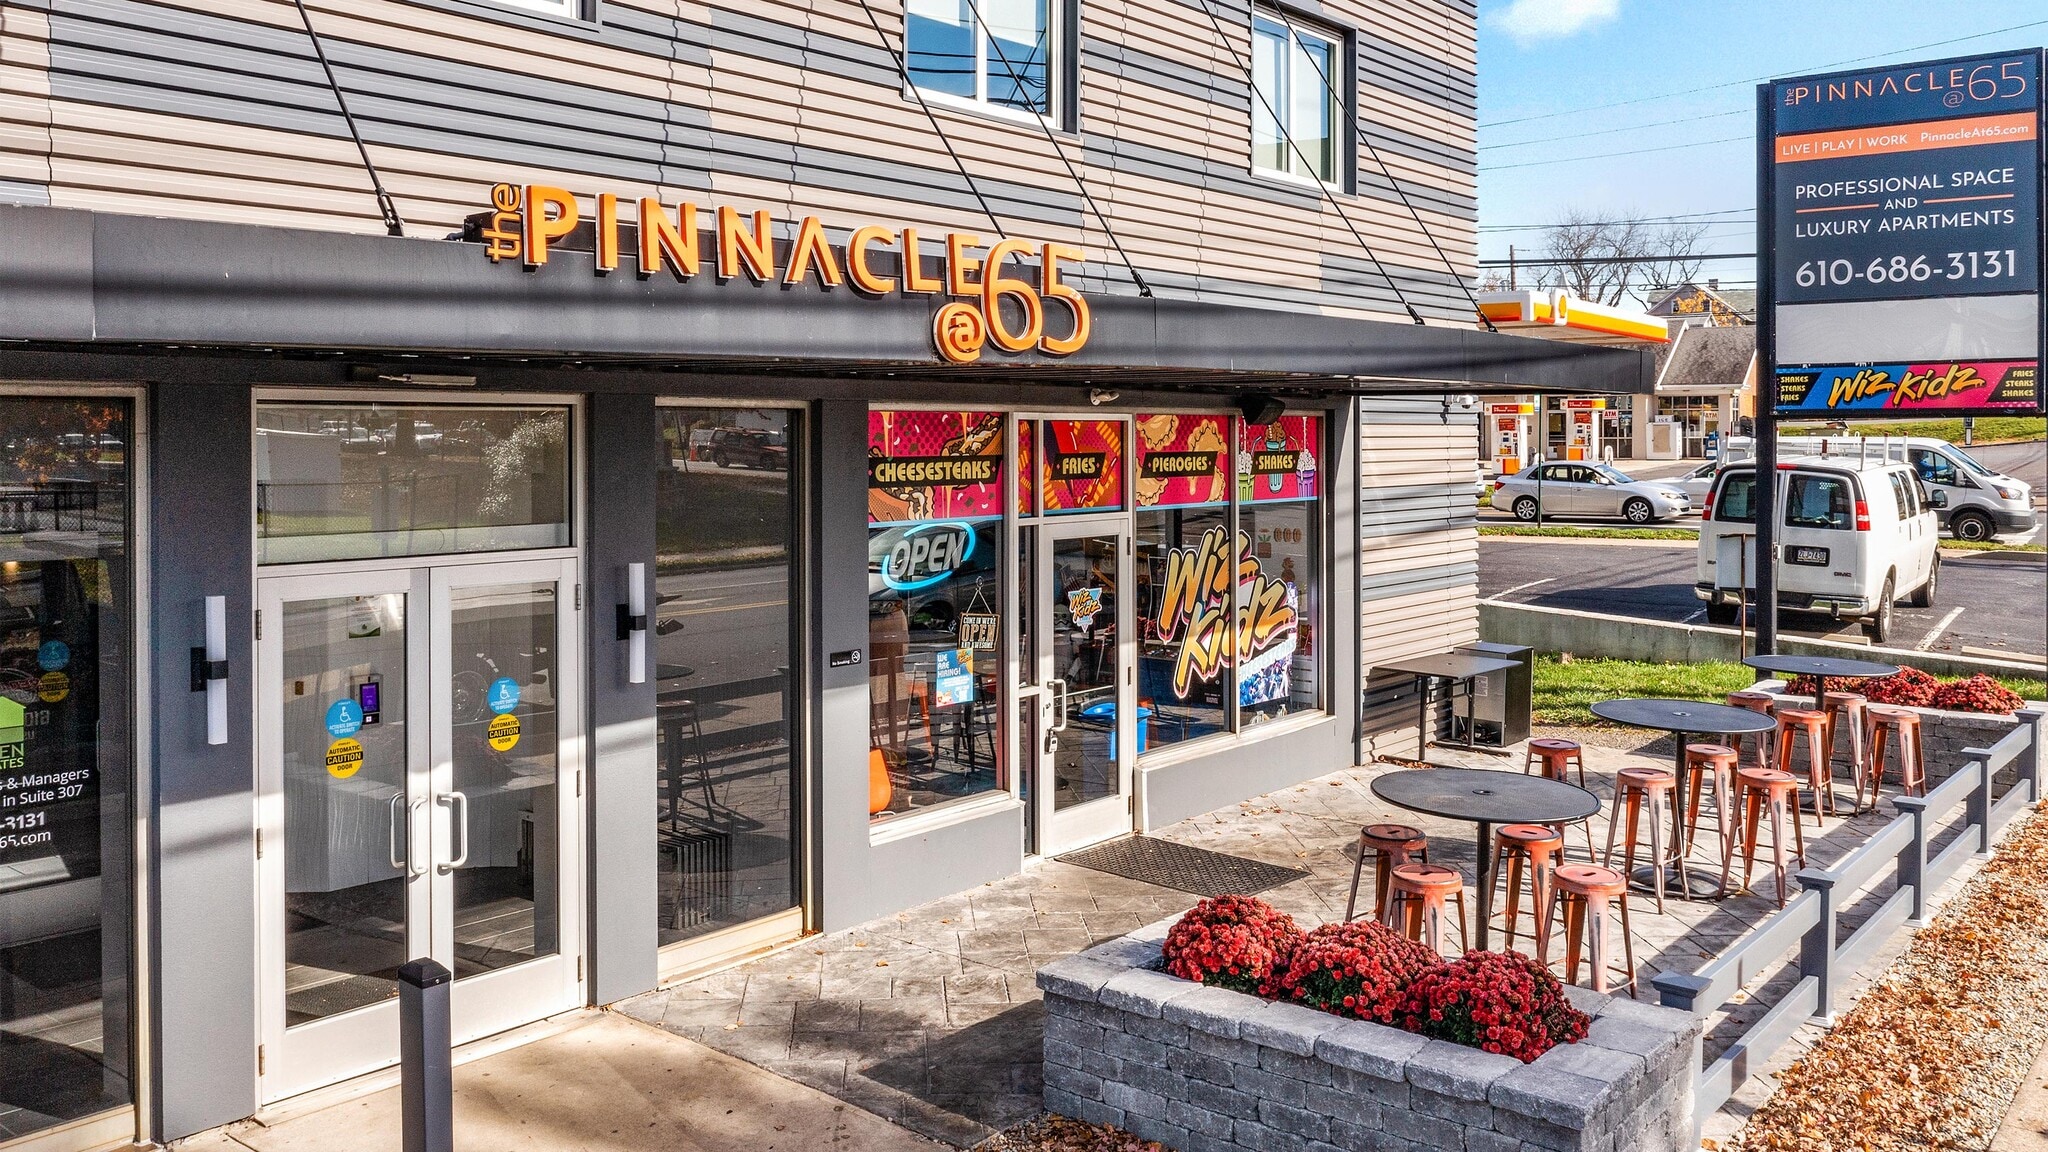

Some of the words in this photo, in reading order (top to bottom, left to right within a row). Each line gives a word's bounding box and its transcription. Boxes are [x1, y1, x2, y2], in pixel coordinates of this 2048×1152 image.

[1784, 88, 1794, 106] the
[1795, 69, 1964, 105] PINNACLE
[1968, 61, 2026, 101] 65
[1782, 143, 1811, 156] LIVE
[1822, 139, 1855, 152] PLAY
[1866, 134, 1908, 147] WORK
[1920, 126, 2029, 142] PinnacleAt65.com
[1796, 174, 1944, 199] PROFESSIONAL
[1951, 167, 2015, 187] SPACE
[1884, 197, 1918, 210] AND
[1796, 218, 1871, 238] LUXURY
[1878, 209, 2014, 232] APARTMENTS
[482, 182, 521, 263] the
[522, 183, 983, 297] PINNACLE
[980, 238, 1090, 353] 65
[1796, 249, 2015, 287] 610-686-3131
[1827, 369, 1897, 409] Wiz
[2002, 389, 2034, 397] SHAKES
[875, 460, 991, 482] CHEESESTEAKS
[1062, 457, 1096, 474] FRIES
[1152, 456, 1208, 472] PIEROGIES
[1258, 455, 1294, 470] SHAKES
[889, 531, 968, 577] OPEN
[1159, 528, 1260, 634] Wiz
[1071, 589, 1091, 610] Wiz
[961, 624, 996, 642] OPEN
[937, 653, 948, 662] WE
[937, 662, 950, 671] ARE
[489, 727, 519, 738] CAUTION
[490, 720, 518, 729] AUTOMATIC
[327, 752, 361, 765] CAUTION
[329, 745, 360, 755] AUTOMATIC
[337, 763, 353, 771] DOOR
[22, 769, 90, 787] Managers
[3, 795, 16, 807] in
[20, 790, 54, 804] Suite
[58, 784, 83, 799] 307
